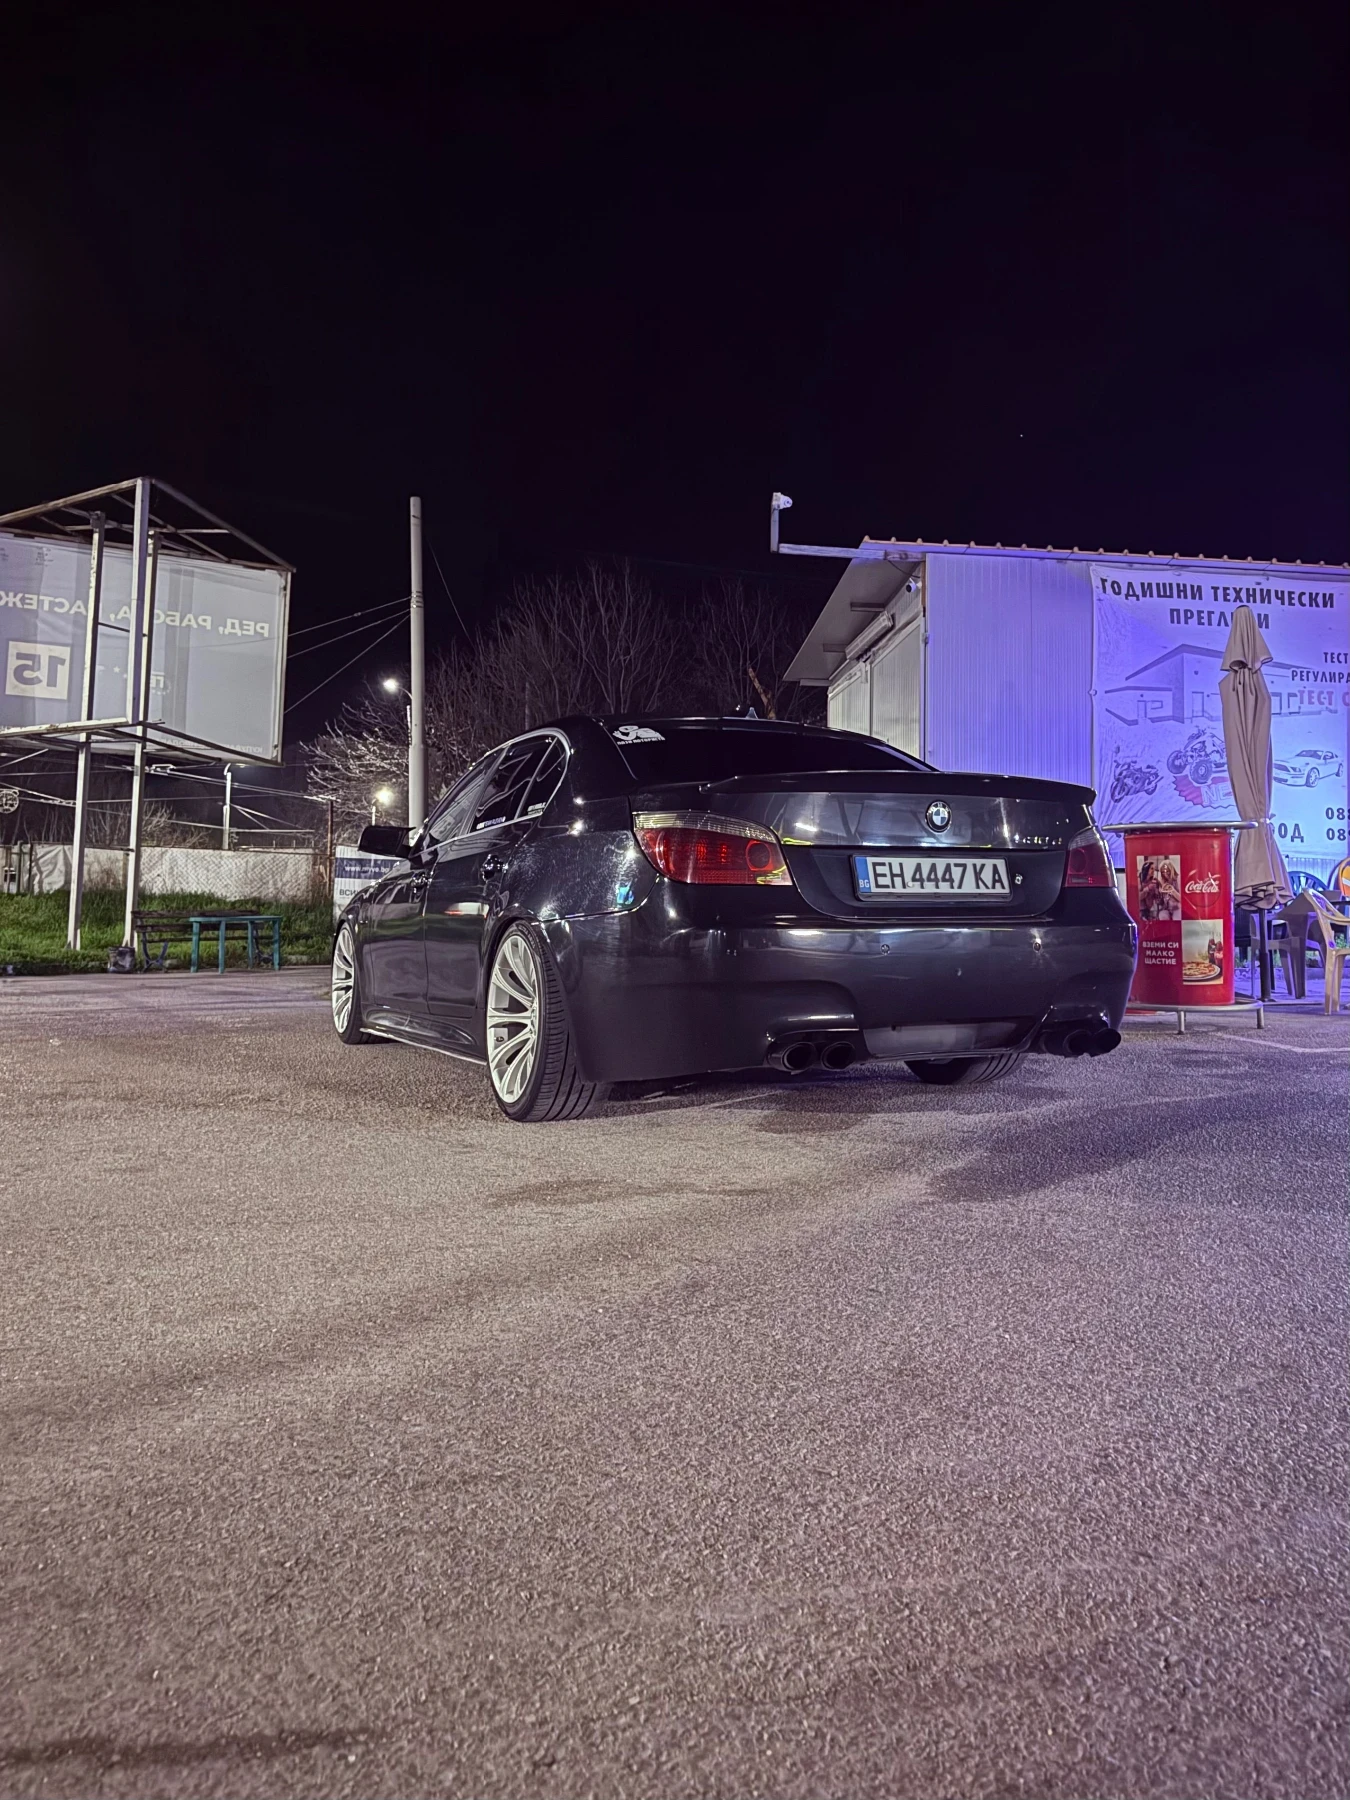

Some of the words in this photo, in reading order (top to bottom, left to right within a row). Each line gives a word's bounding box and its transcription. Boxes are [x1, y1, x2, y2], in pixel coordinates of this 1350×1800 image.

[1100, 577, 1203, 601] ГОДИШНИ
[1211, 586, 1335, 609] ТЕХНИЧЕСКИ
[1169, 608, 1270, 630] ПРЕГЛИ
[1323, 652, 1349, 664] ТЕСТ
[1298, 689, 1334, 706] ТЕСТ
[1201, 783, 1232, 804] NE
[859, 879, 870, 889] BG
[911, 862, 967, 890] 4447
[972, 863, 1006, 890] KA
[339, 888, 360, 896] ВСИ
[1167, 941, 1179, 949] СИ
